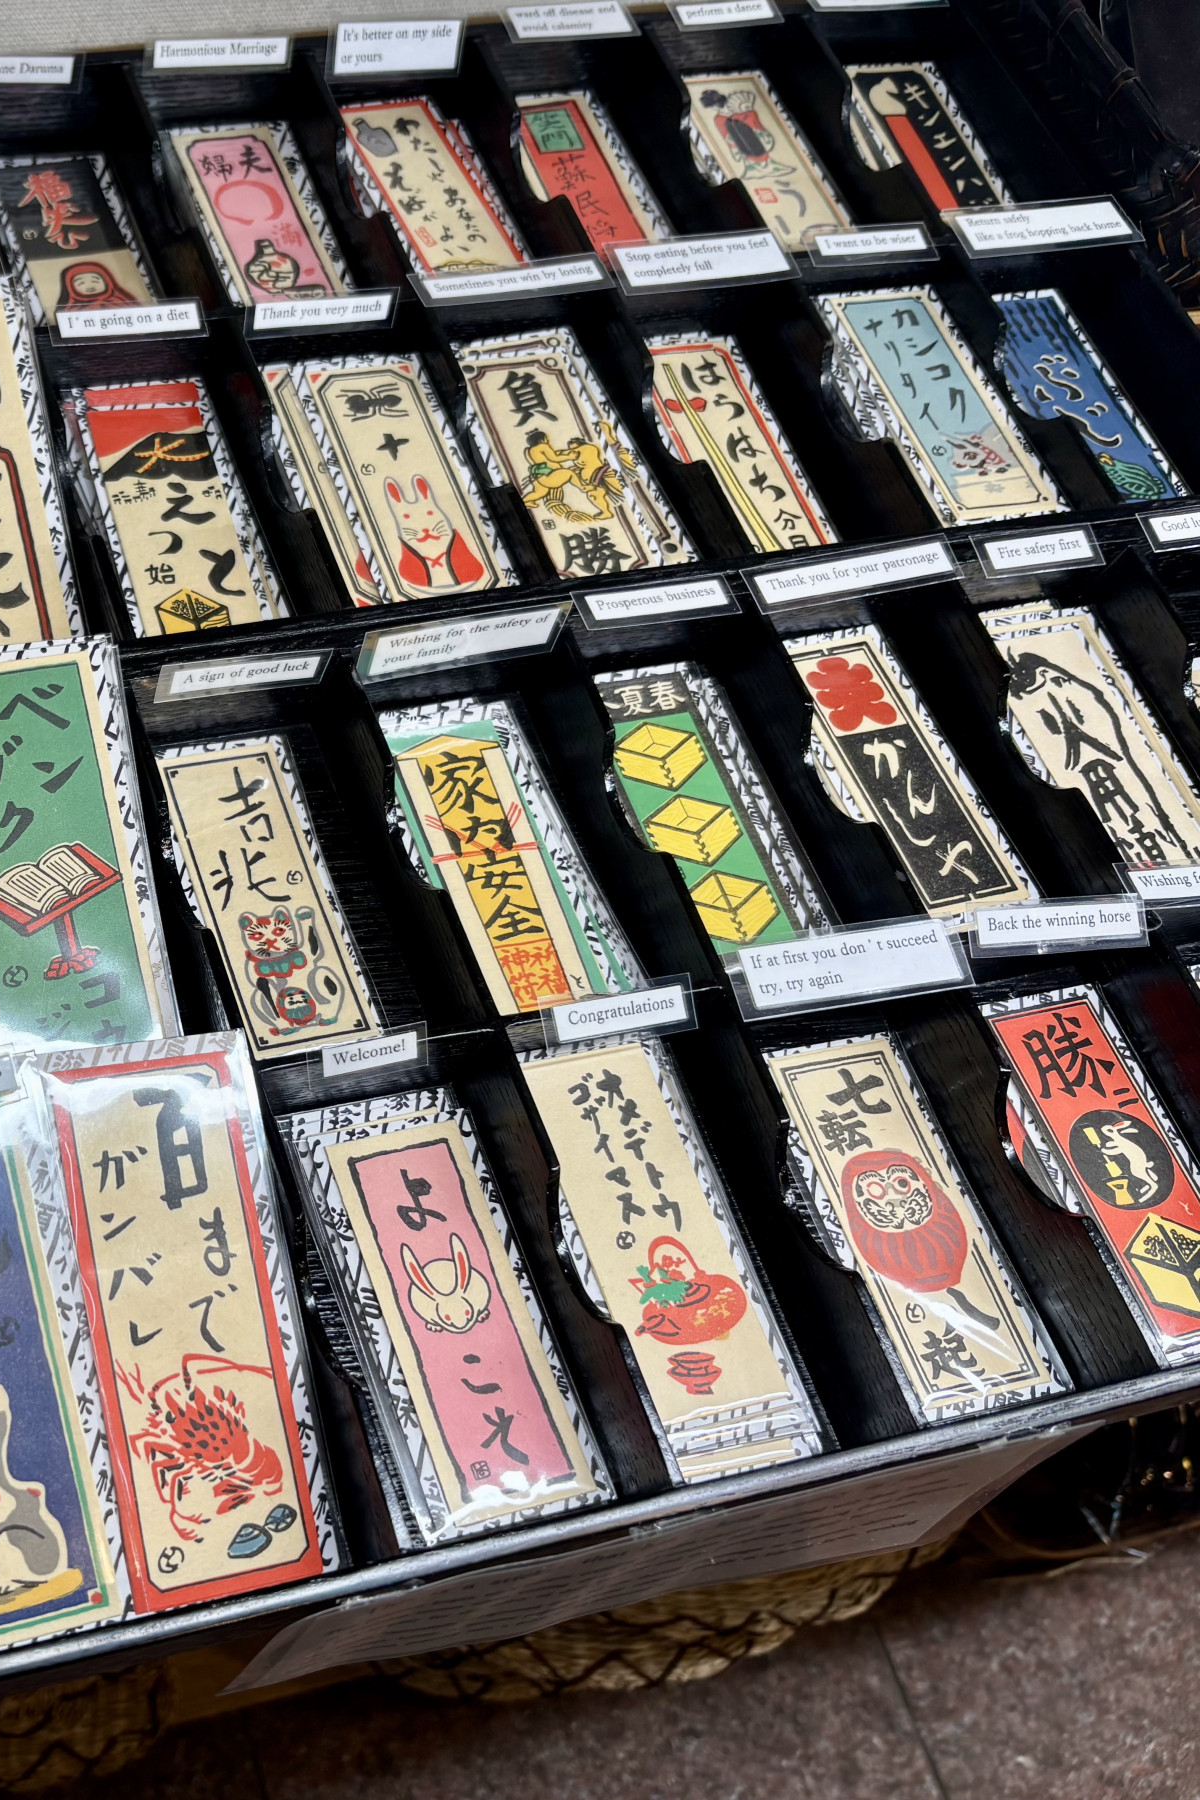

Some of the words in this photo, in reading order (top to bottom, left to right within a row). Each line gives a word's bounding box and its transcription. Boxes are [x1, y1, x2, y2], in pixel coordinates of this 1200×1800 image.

[160, 43, 226, 58] Harmonious
[229, 41, 278, 57] Marriage
[624, 252, 652, 263] Stop
[653, 247, 689, 260] eating
[688, 243, 724, 255] before
[726, 243, 747, 254] you
[747, 236, 769, 250] feel
[633, 263, 691, 278] completely
[693, 259, 713, 271] full
[260, 305, 297, 320] Thank
[299, 307, 321, 320] you
[325, 305, 349, 317] very
[351, 299, 382, 314] much
[499, 371, 558, 427] 負
[996, 546, 1022, 559] Fire
[1023, 541, 1056, 556] safety
[1058, 538, 1082, 551] first
[595, 595, 664, 611] Prosperous
[663, 587, 716, 602] business
[390, 633, 442, 649] Wishing
[446, 628, 466, 639] for
[469, 624, 490, 634] the
[493, 618, 532, 630] safety
[535, 613, 552, 624] of
[382, 653, 413, 668] your
[416, 643, 457, 659] family
[183, 674, 194, 684] A
[198, 671, 225, 683] sign
[229, 667, 246, 678] of
[246, 663, 281, 679] good
[282, 660, 310, 672] luck
[424, 750, 546, 942] 家内安全
[987, 915, 1019, 932] Back
[1022, 914, 1042, 929] the
[1045, 911, 1096, 928] winning
[1099, 909, 1132, 924] horse
[749, 954, 763, 969] If
[766, 955, 781, 967] at
[782, 950, 809, 965] first
[811, 948, 838, 965] you
[887, 930, 938, 949] succeed
[758, 983, 783, 996] try,
[785, 979, 804, 993] try
[808, 970, 844, 990] again
[567, 997, 675, 1026] Congratulations
[332, 1038, 405, 1065] Welcome!
[92, 1145, 163, 1348] ガンバレ
